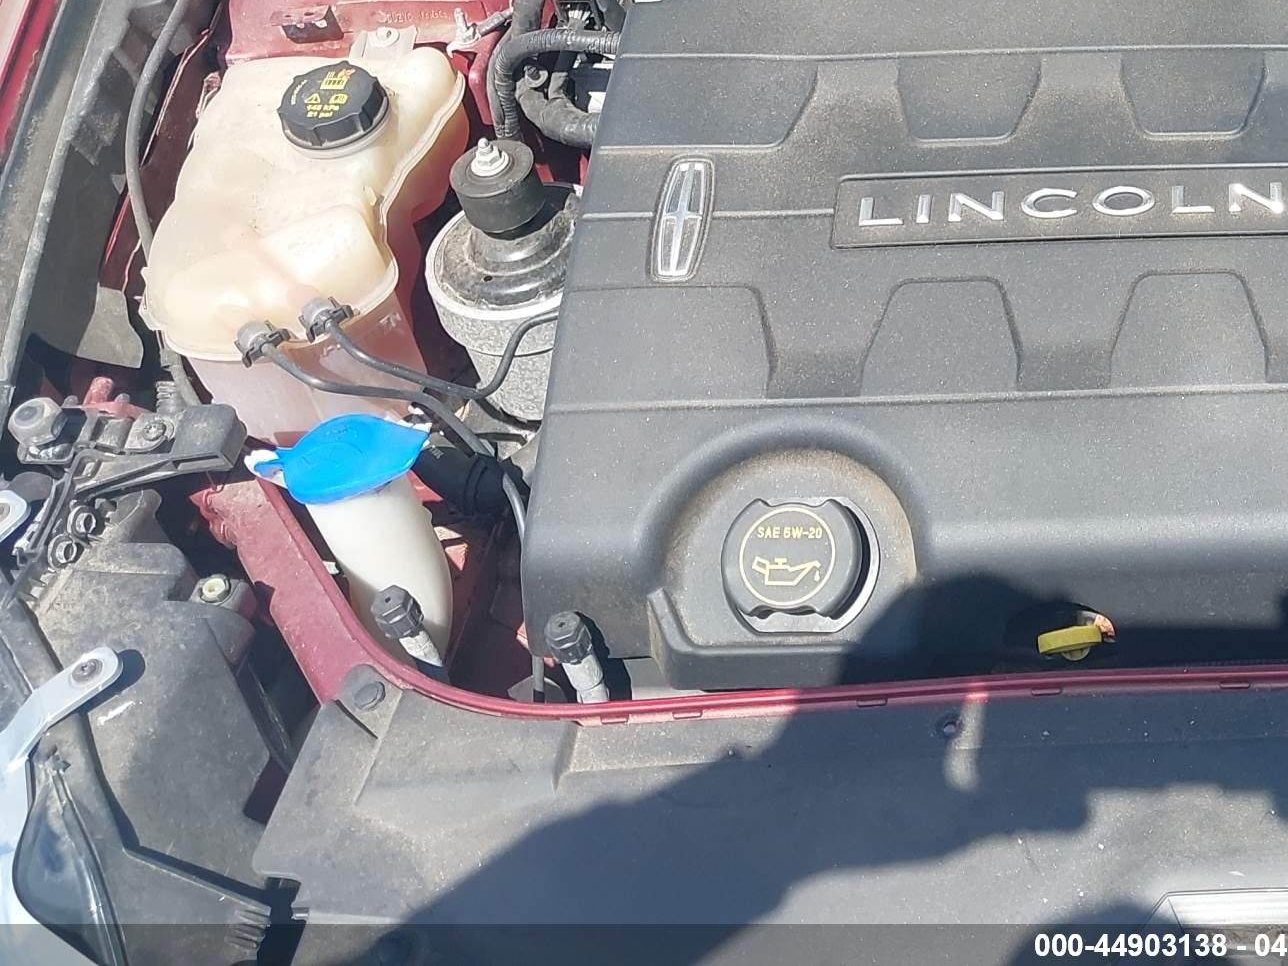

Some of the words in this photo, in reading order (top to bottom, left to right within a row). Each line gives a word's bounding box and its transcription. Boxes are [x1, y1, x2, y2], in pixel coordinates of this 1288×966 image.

[857, 181, 1287, 228] LINCOLN
[757, 527, 780, 538] SAE
[783, 527, 823, 539] 5W-20
